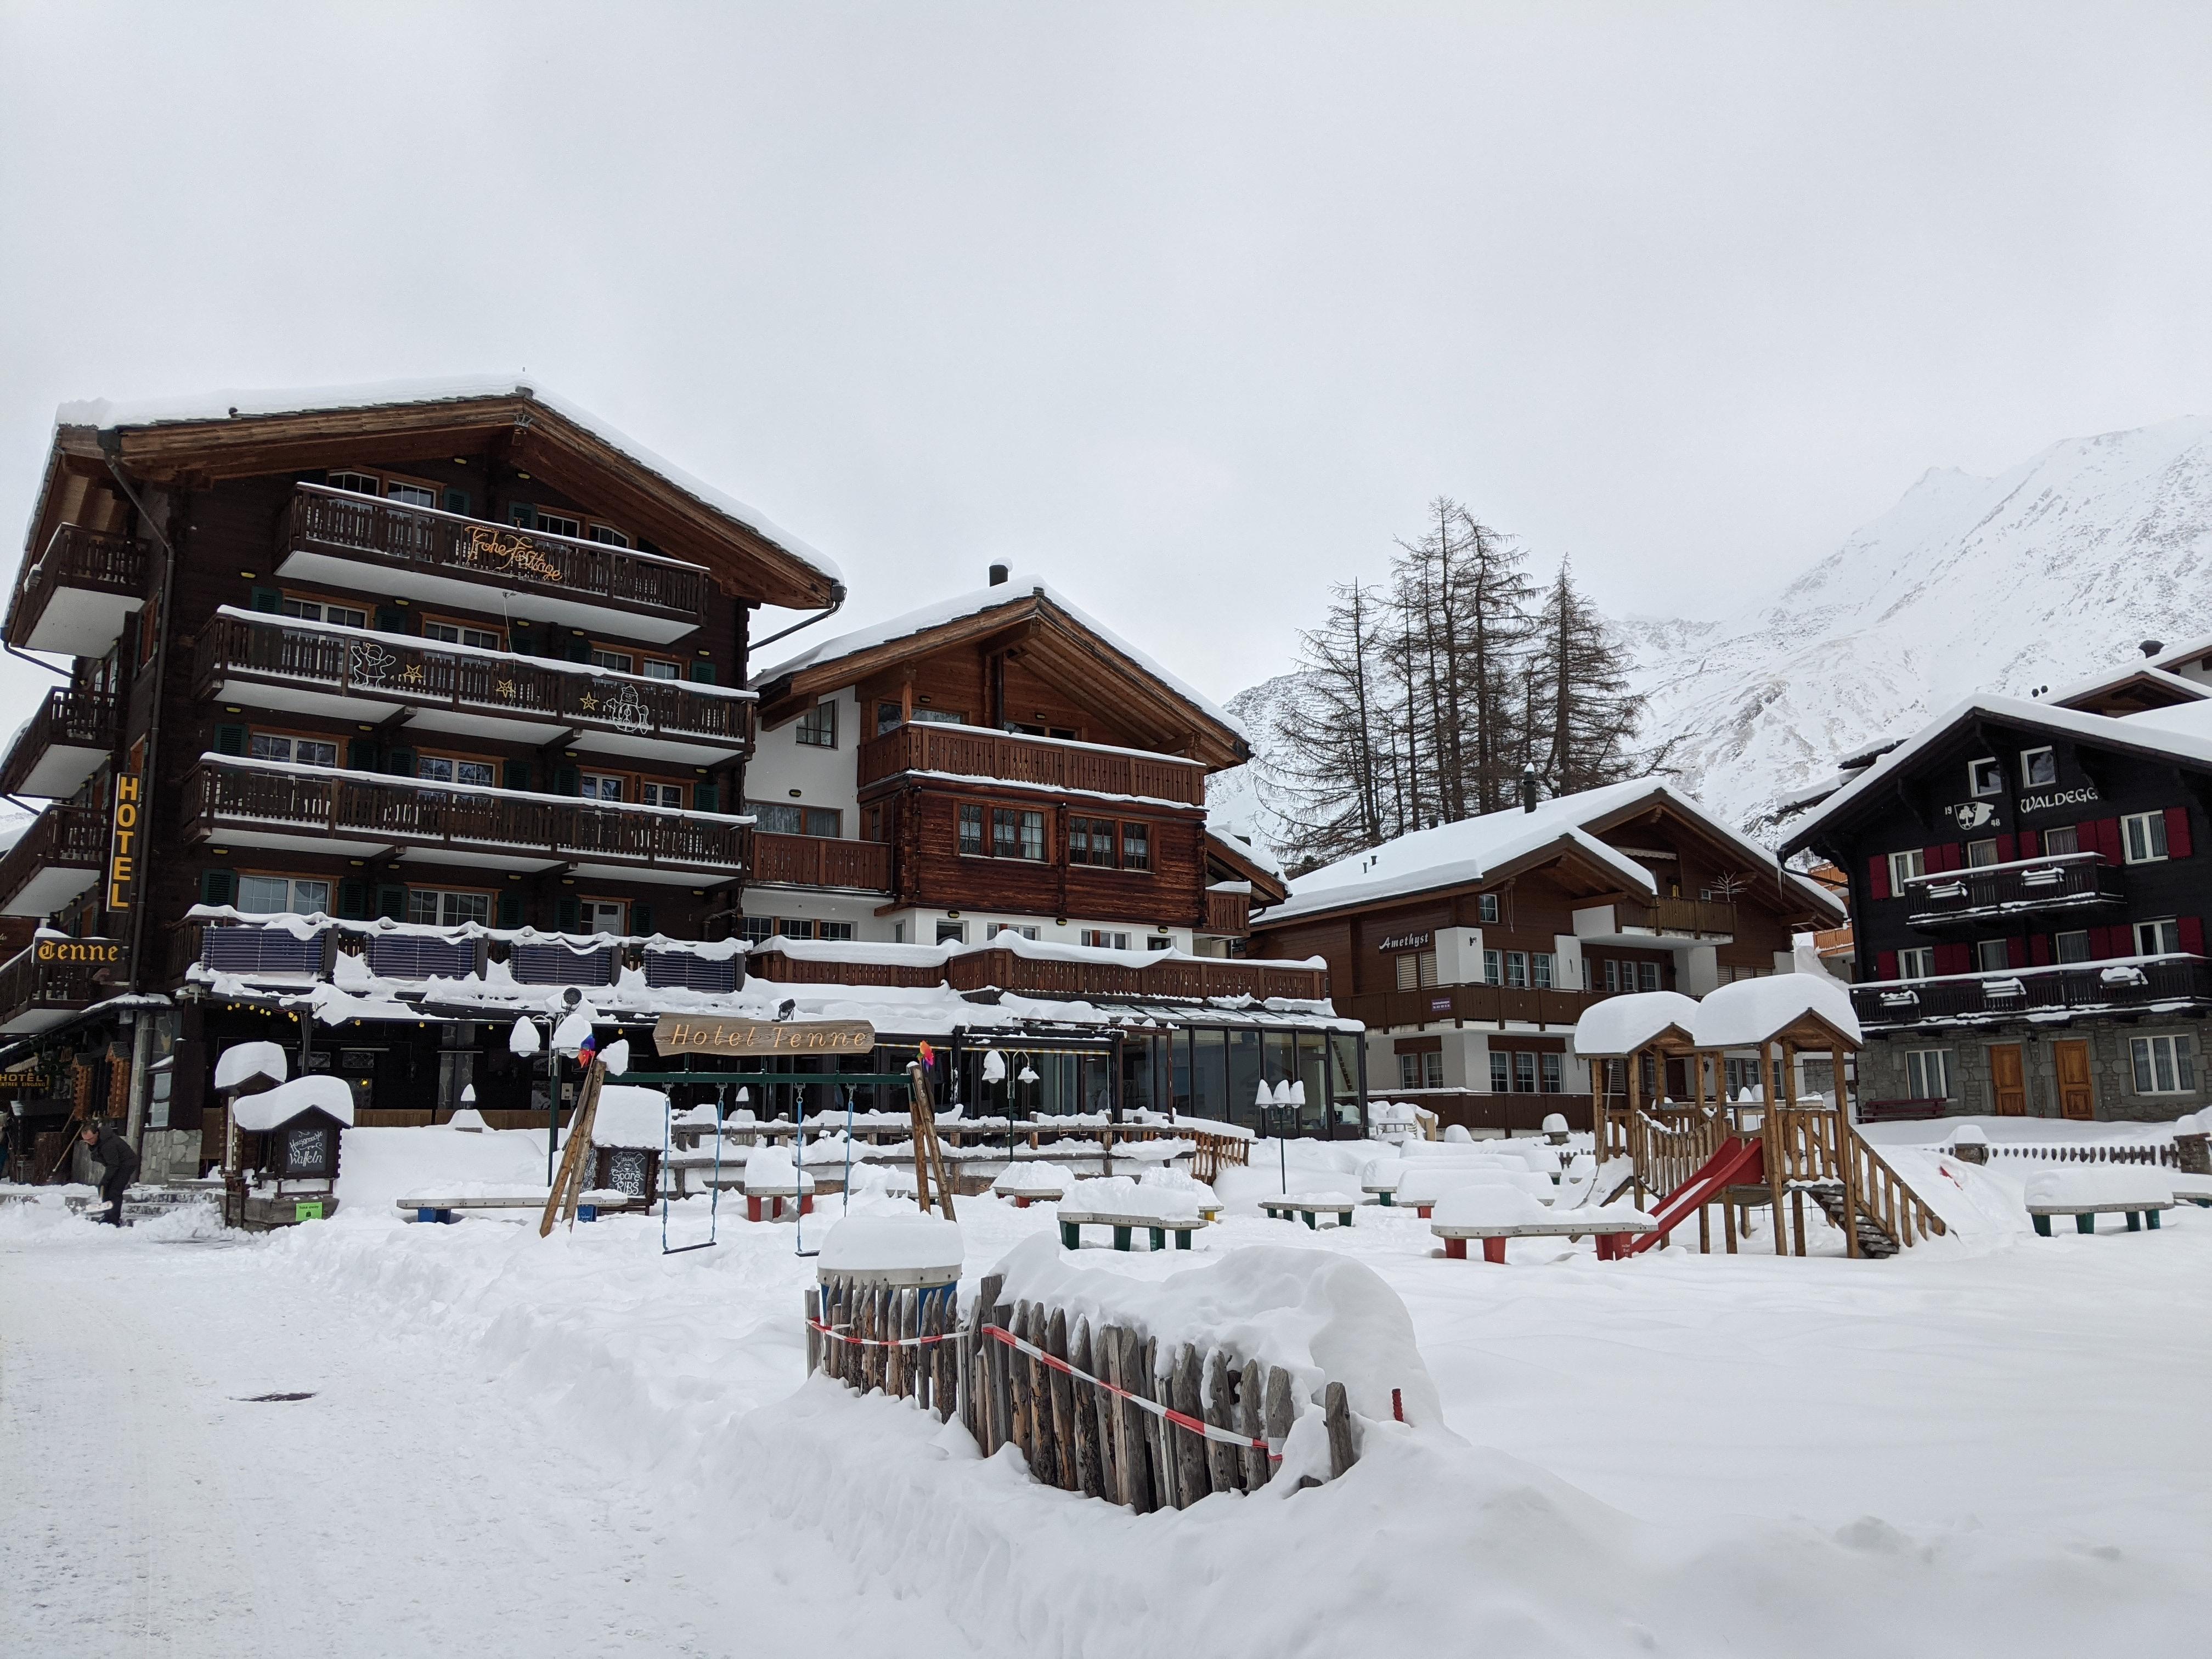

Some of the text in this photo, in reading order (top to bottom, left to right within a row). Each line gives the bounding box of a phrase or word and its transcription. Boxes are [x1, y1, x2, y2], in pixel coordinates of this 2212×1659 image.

[2020, 787, 2098, 814] WALDEGG
[1945, 806, 1952, 815] 19
[1991, 819, 2000, 827] 48
[111, 776, 138, 907] HOTEL
[1379, 933, 1429, 950] Amethyst
[38, 940, 119, 962] Tenne
[671, 1024, 866, 1048] Hotel Tenne
[289, 1149, 323, 1167] Waffeln
[612, 1169, 641, 1184] Spare
[615, 1181, 639, 1195] RIBS
